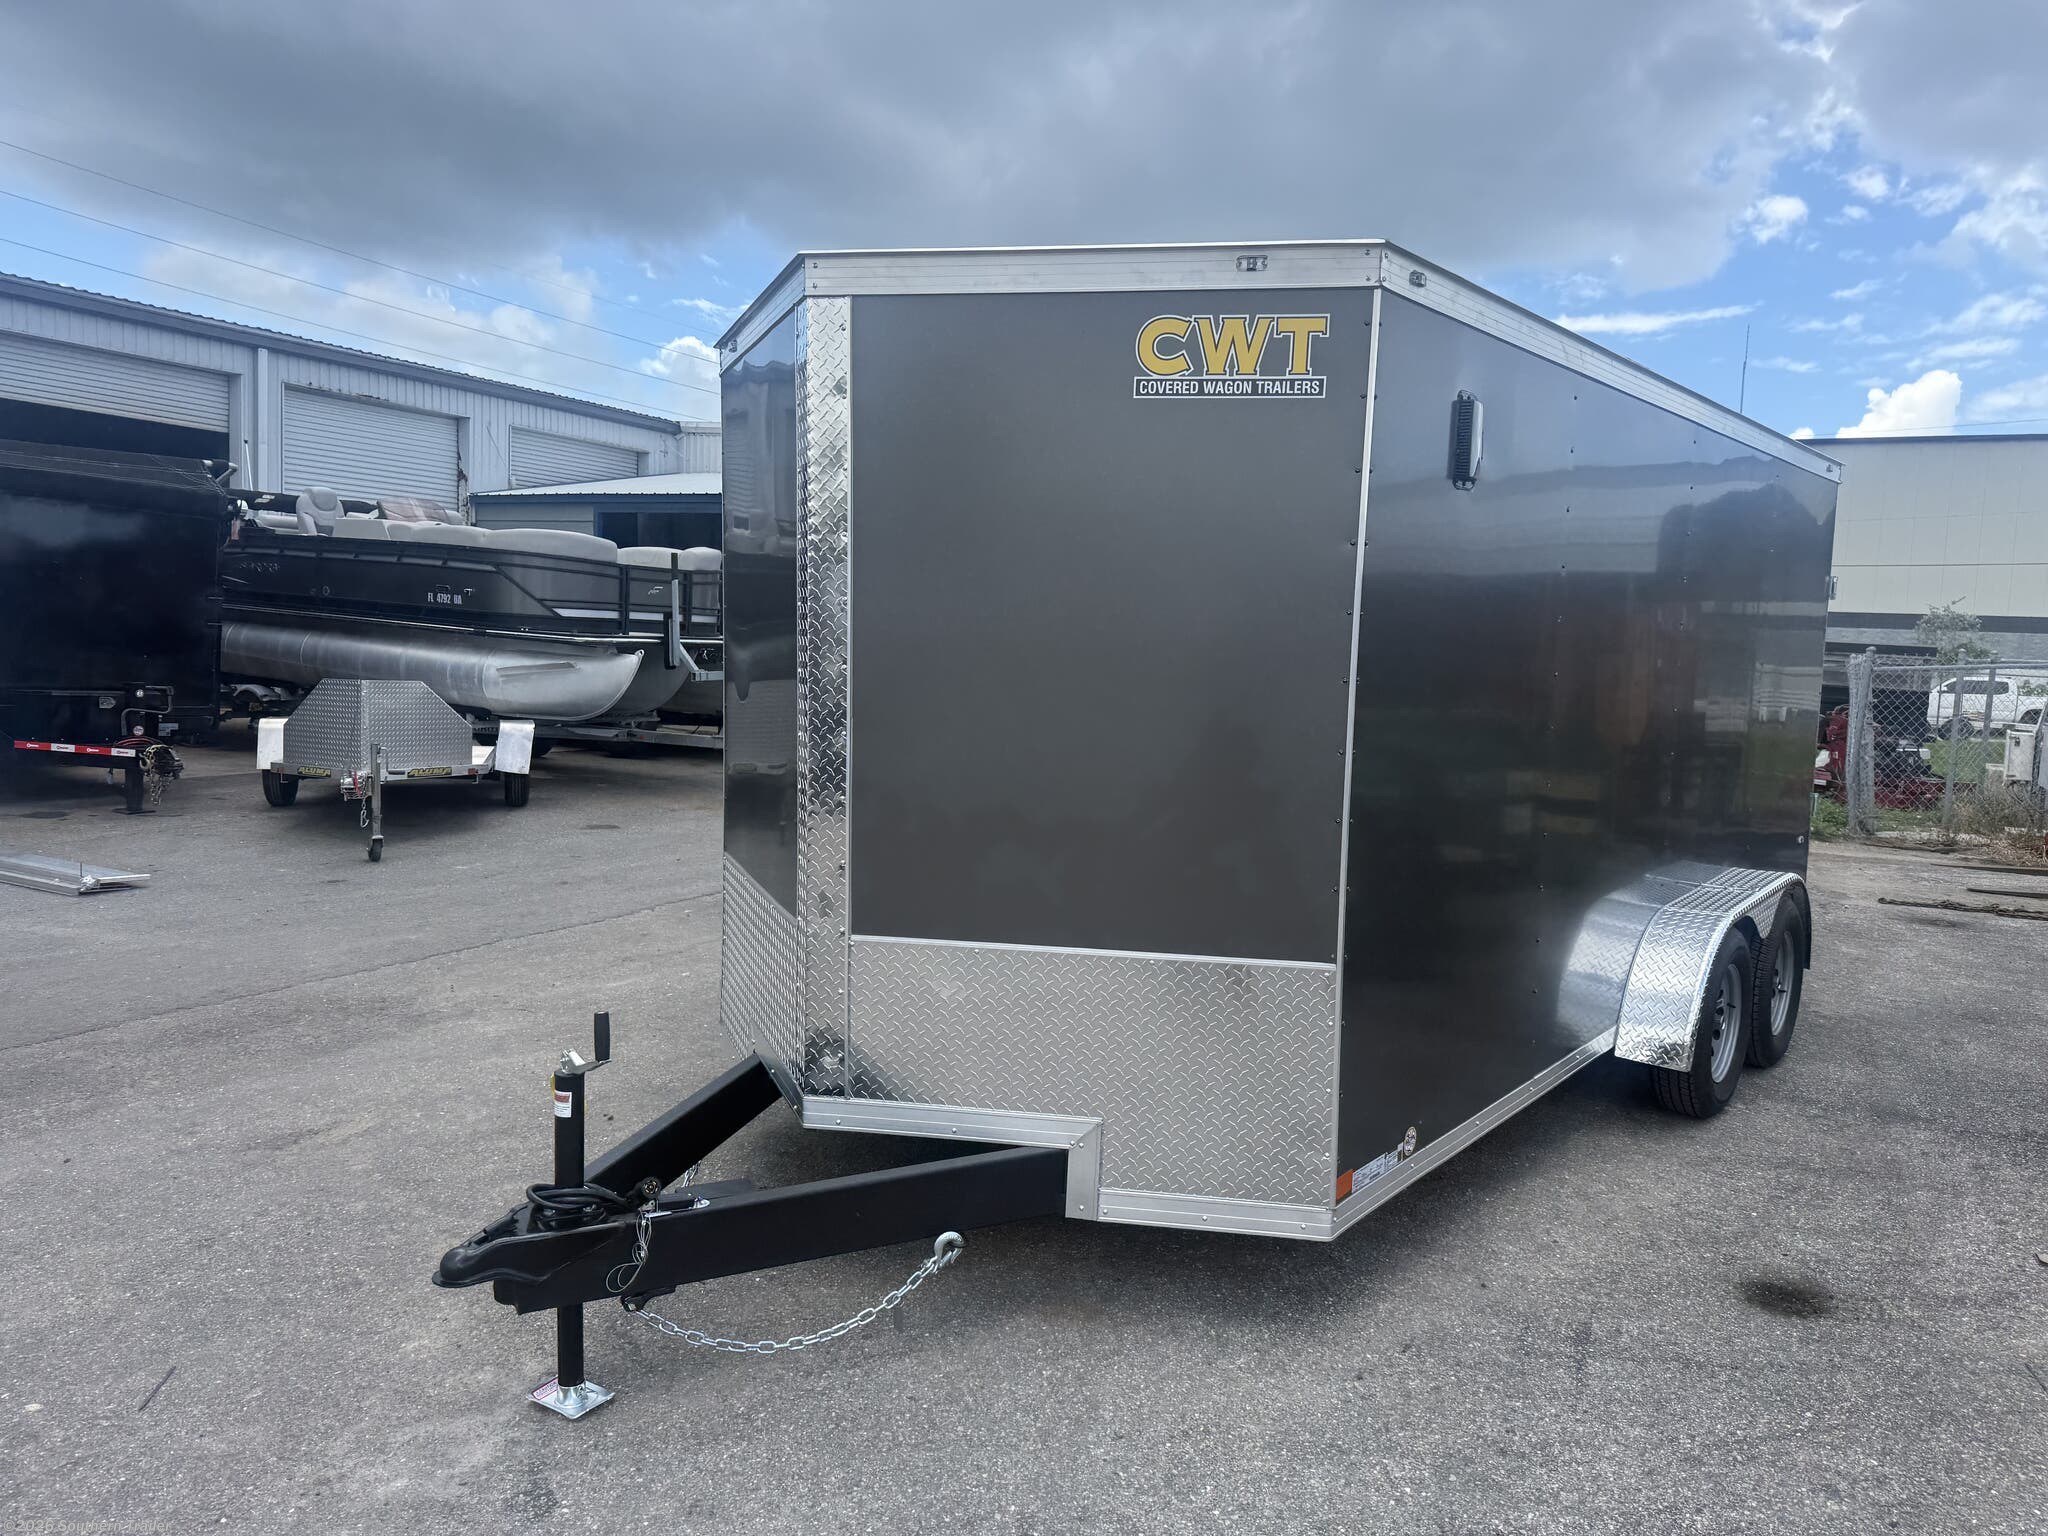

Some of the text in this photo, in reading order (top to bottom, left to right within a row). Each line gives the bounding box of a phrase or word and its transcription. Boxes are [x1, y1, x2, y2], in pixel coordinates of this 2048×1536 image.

[1135, 314, 1331, 377] CWT
[1139, 380, 1320, 394] COVERED WAGON TRAILERS
